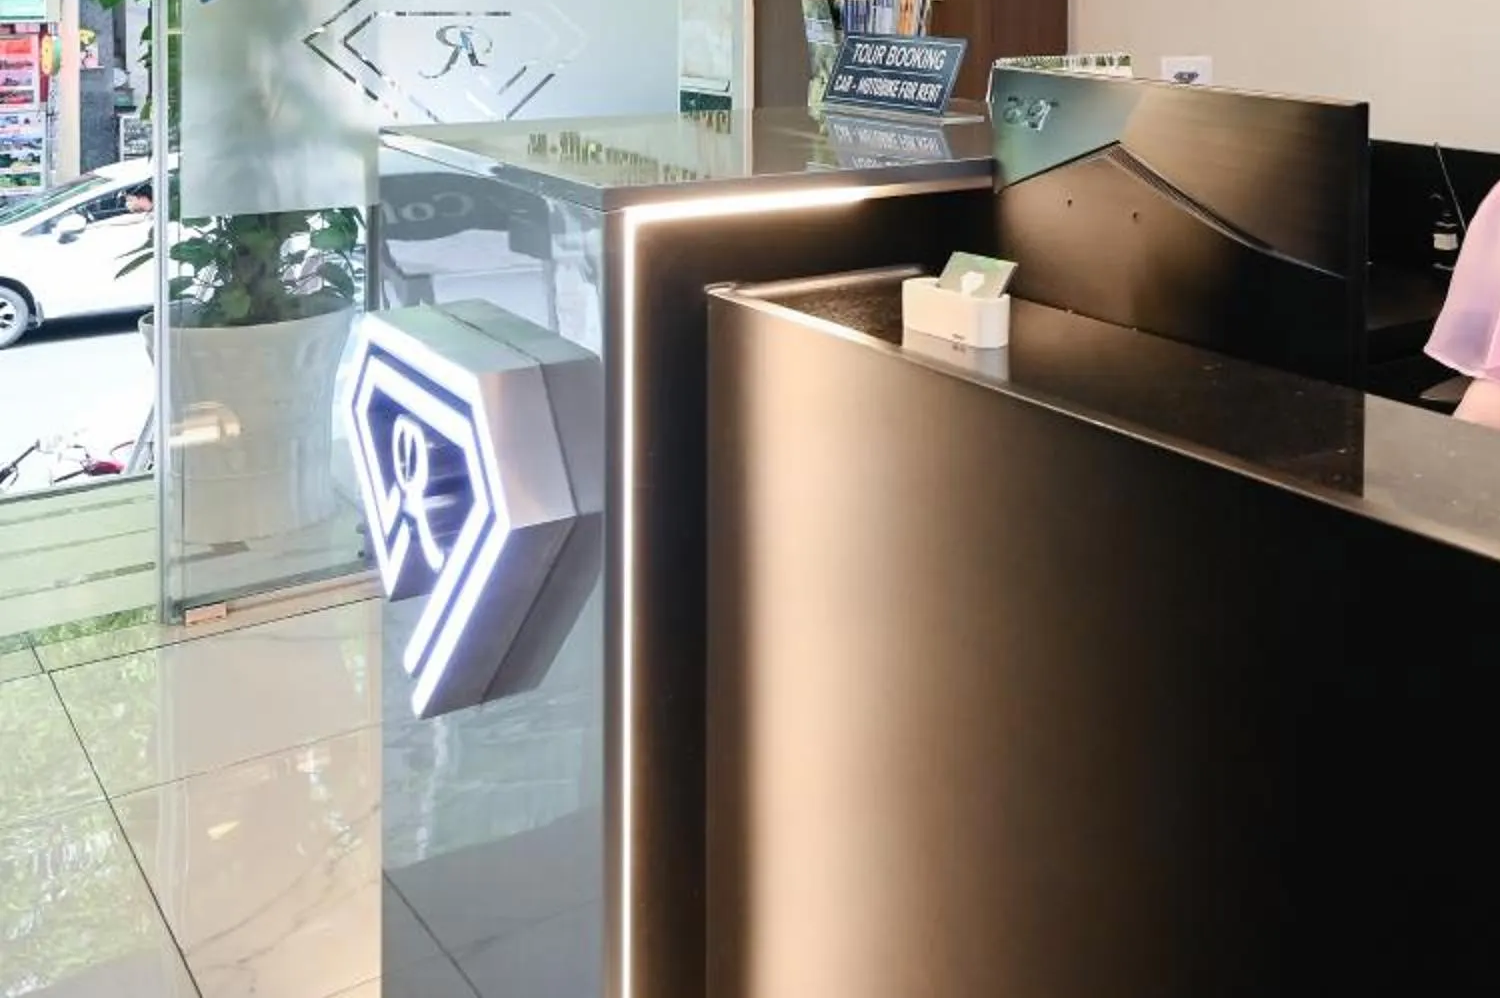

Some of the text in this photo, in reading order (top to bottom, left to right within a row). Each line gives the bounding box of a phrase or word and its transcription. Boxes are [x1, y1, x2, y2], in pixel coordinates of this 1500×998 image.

[852, 43, 947, 71] TOUR BOOKING
[834, 74, 854, 93] CAR
[898, 80, 919, 101] FOR
[915, 82, 943, 103] RENT
